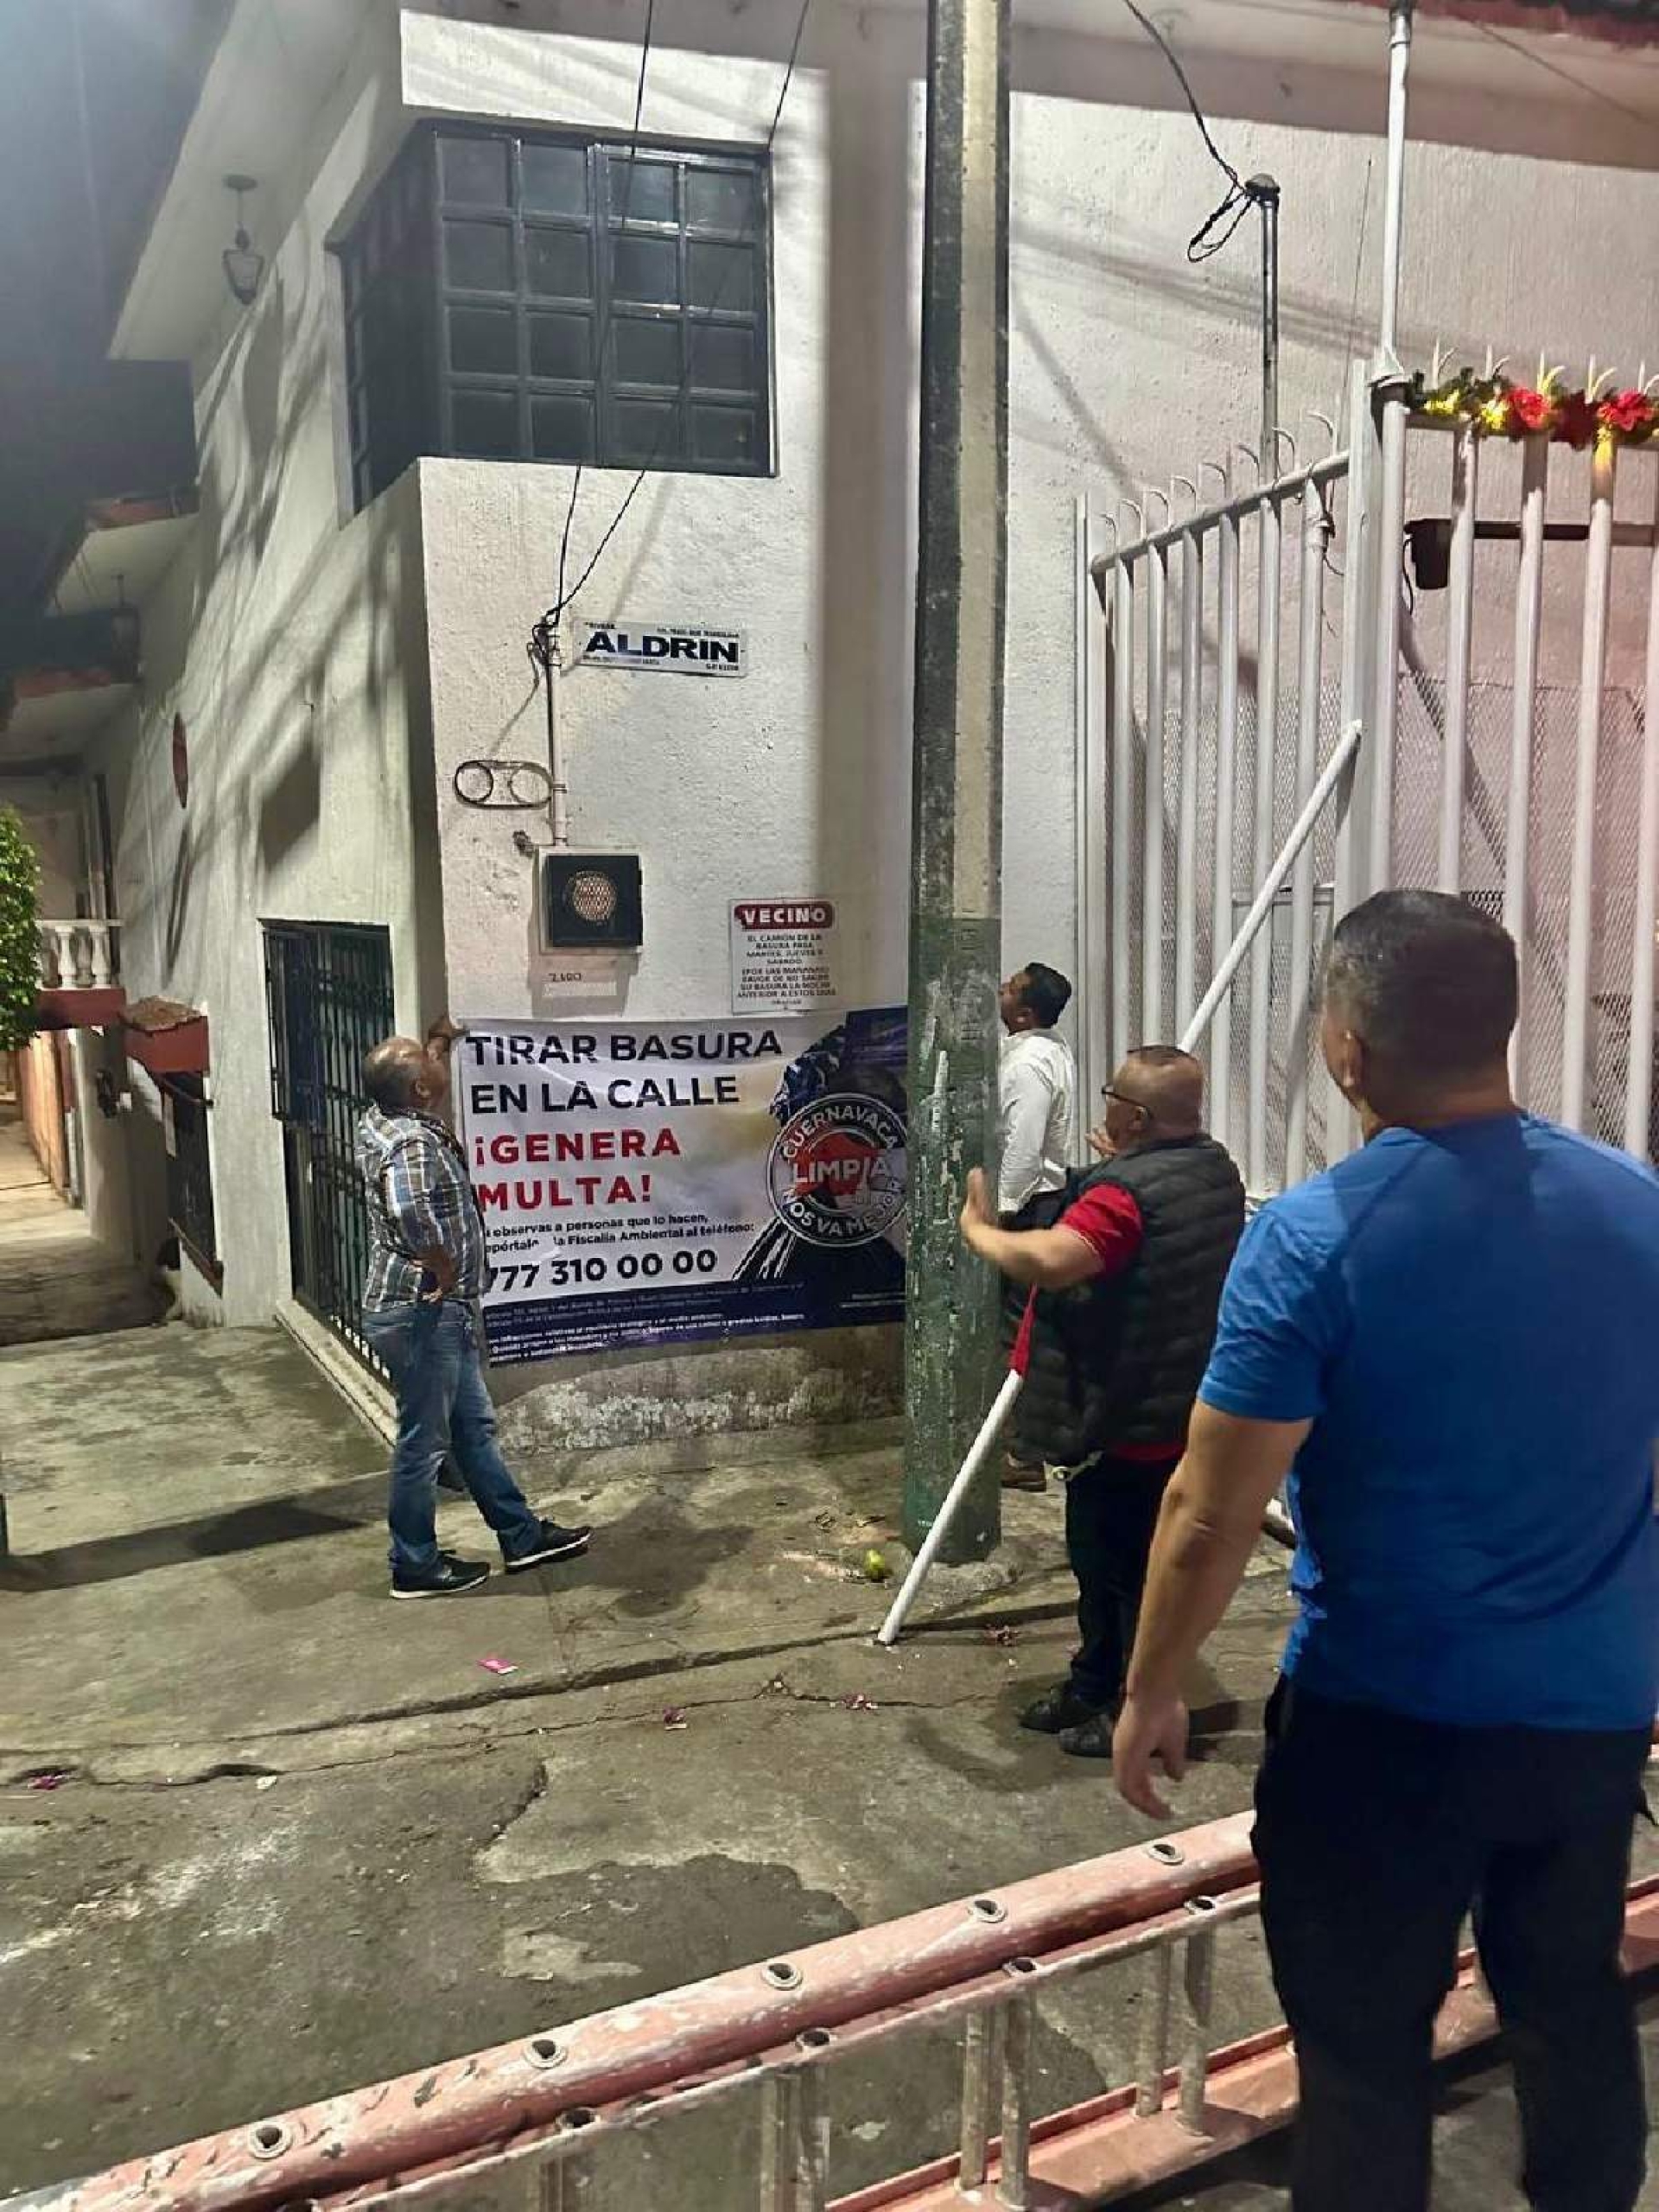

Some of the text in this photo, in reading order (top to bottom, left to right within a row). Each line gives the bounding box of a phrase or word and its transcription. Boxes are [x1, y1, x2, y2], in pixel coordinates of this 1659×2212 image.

[586, 631, 739, 663] ALDRIN
[743, 907, 826, 923] VECINO
[466, 1029, 783, 1065] TIRAR BASURA
[471, 1075, 741, 1115] EN LA CALLE
[475, 1127, 681, 1166] ¡GENERA
[783, 1104, 898, 1160] CUERNAVACA
[792, 1156, 887, 1184] LIMPIA
[478, 1173, 651, 1212] MULTA!
[493, 1223, 552, 1236] observas
[555, 1223, 562, 1231] a
[566, 1218, 624, 1232] personas
[627, 1217, 650, 1228] que
[653, 1215, 665, 1224] lo
[669, 1214, 709, 1224] hacen,
[620, 1228, 683, 1241] Ambiental
[686, 1225, 698, 1236] al
[700, 1223, 754, 1235] teléfono:
[817, 1215, 843, 1238] VA
[486, 1249, 718, 1294] 777 310 00 00
